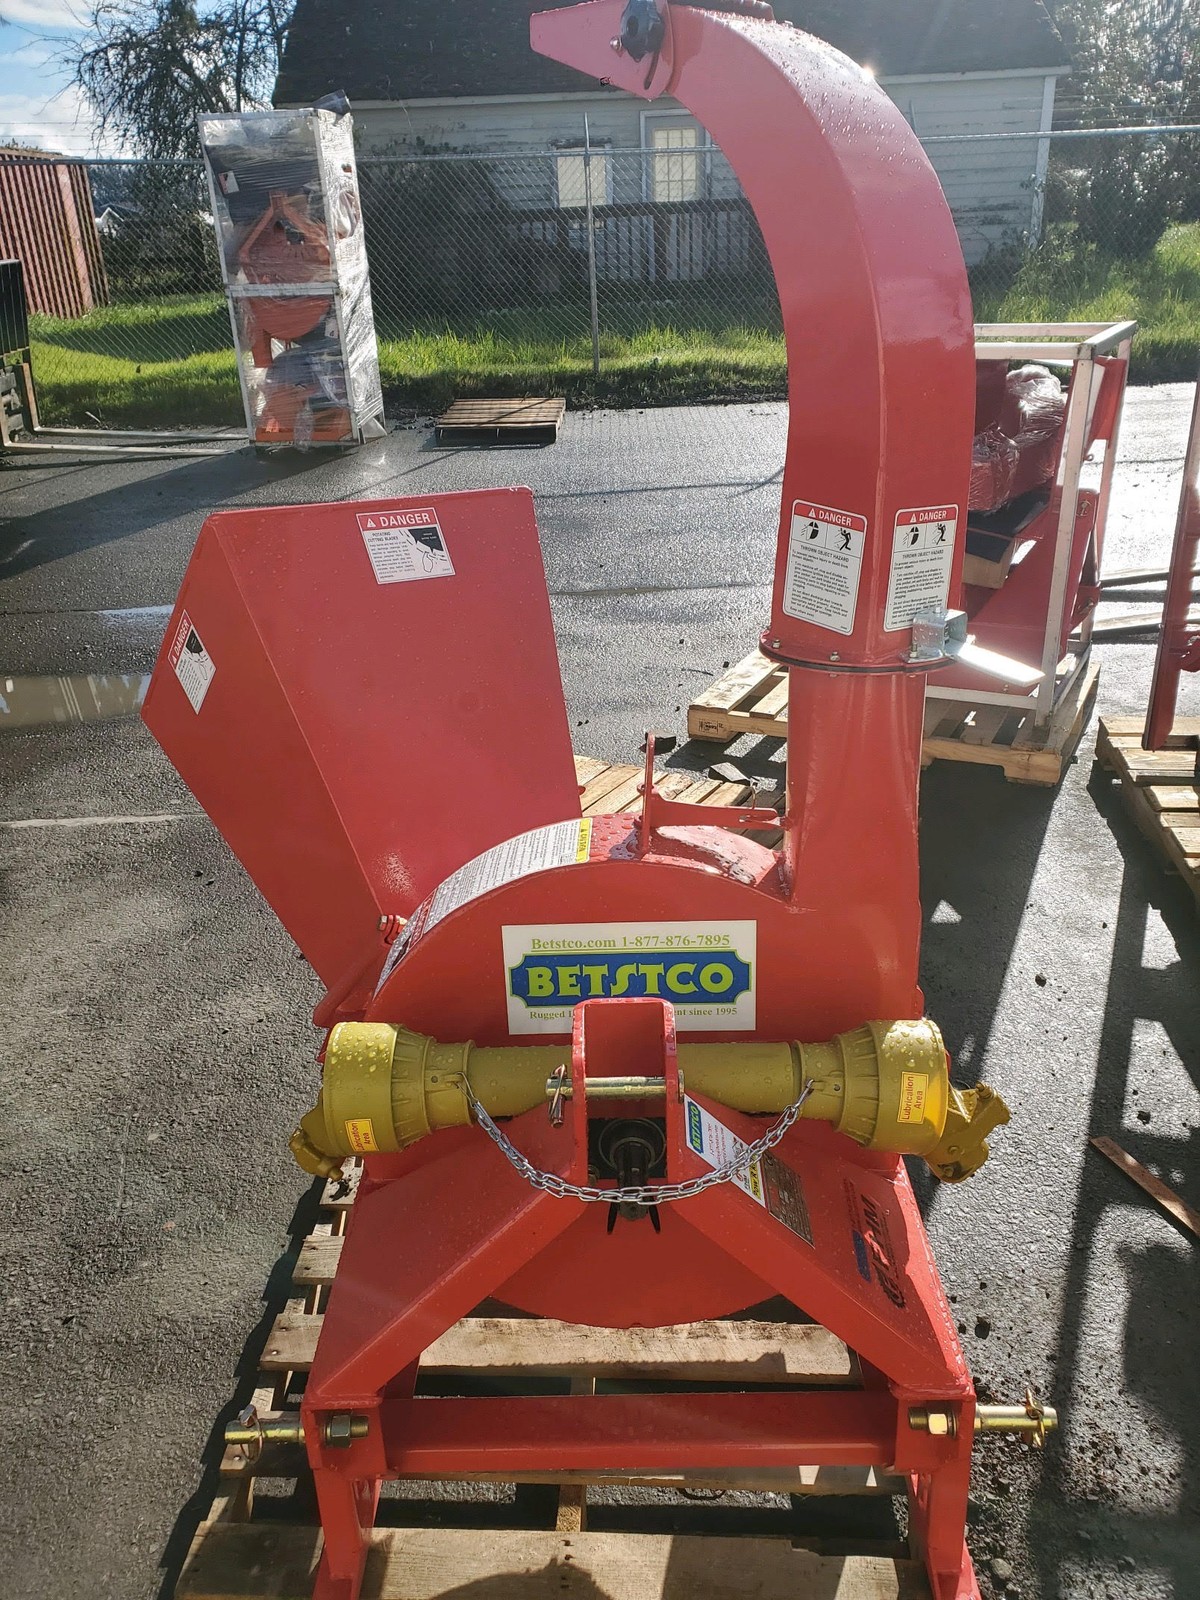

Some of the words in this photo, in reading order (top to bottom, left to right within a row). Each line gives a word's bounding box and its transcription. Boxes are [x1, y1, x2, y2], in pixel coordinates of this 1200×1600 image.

[380, 513, 431, 526] DANGER
[819, 511, 851, 526] DANGER
[919, 510, 946, 521] DANGER
[174, 619, 189, 655] DANGER
[531, 938, 616, 949] Betstco.com
[622, 934, 730, 947] 1-877-876-7895
[525, 962, 734, 996] BETSTCO
[530, 1011, 565, 1020] Rugged
[902, 1076, 914, 1120] Lubrication
[914, 1090, 923, 1109] Area
[690, 1105, 700, 1149] BETSTCO
[363, 1133, 371, 1144] Area
